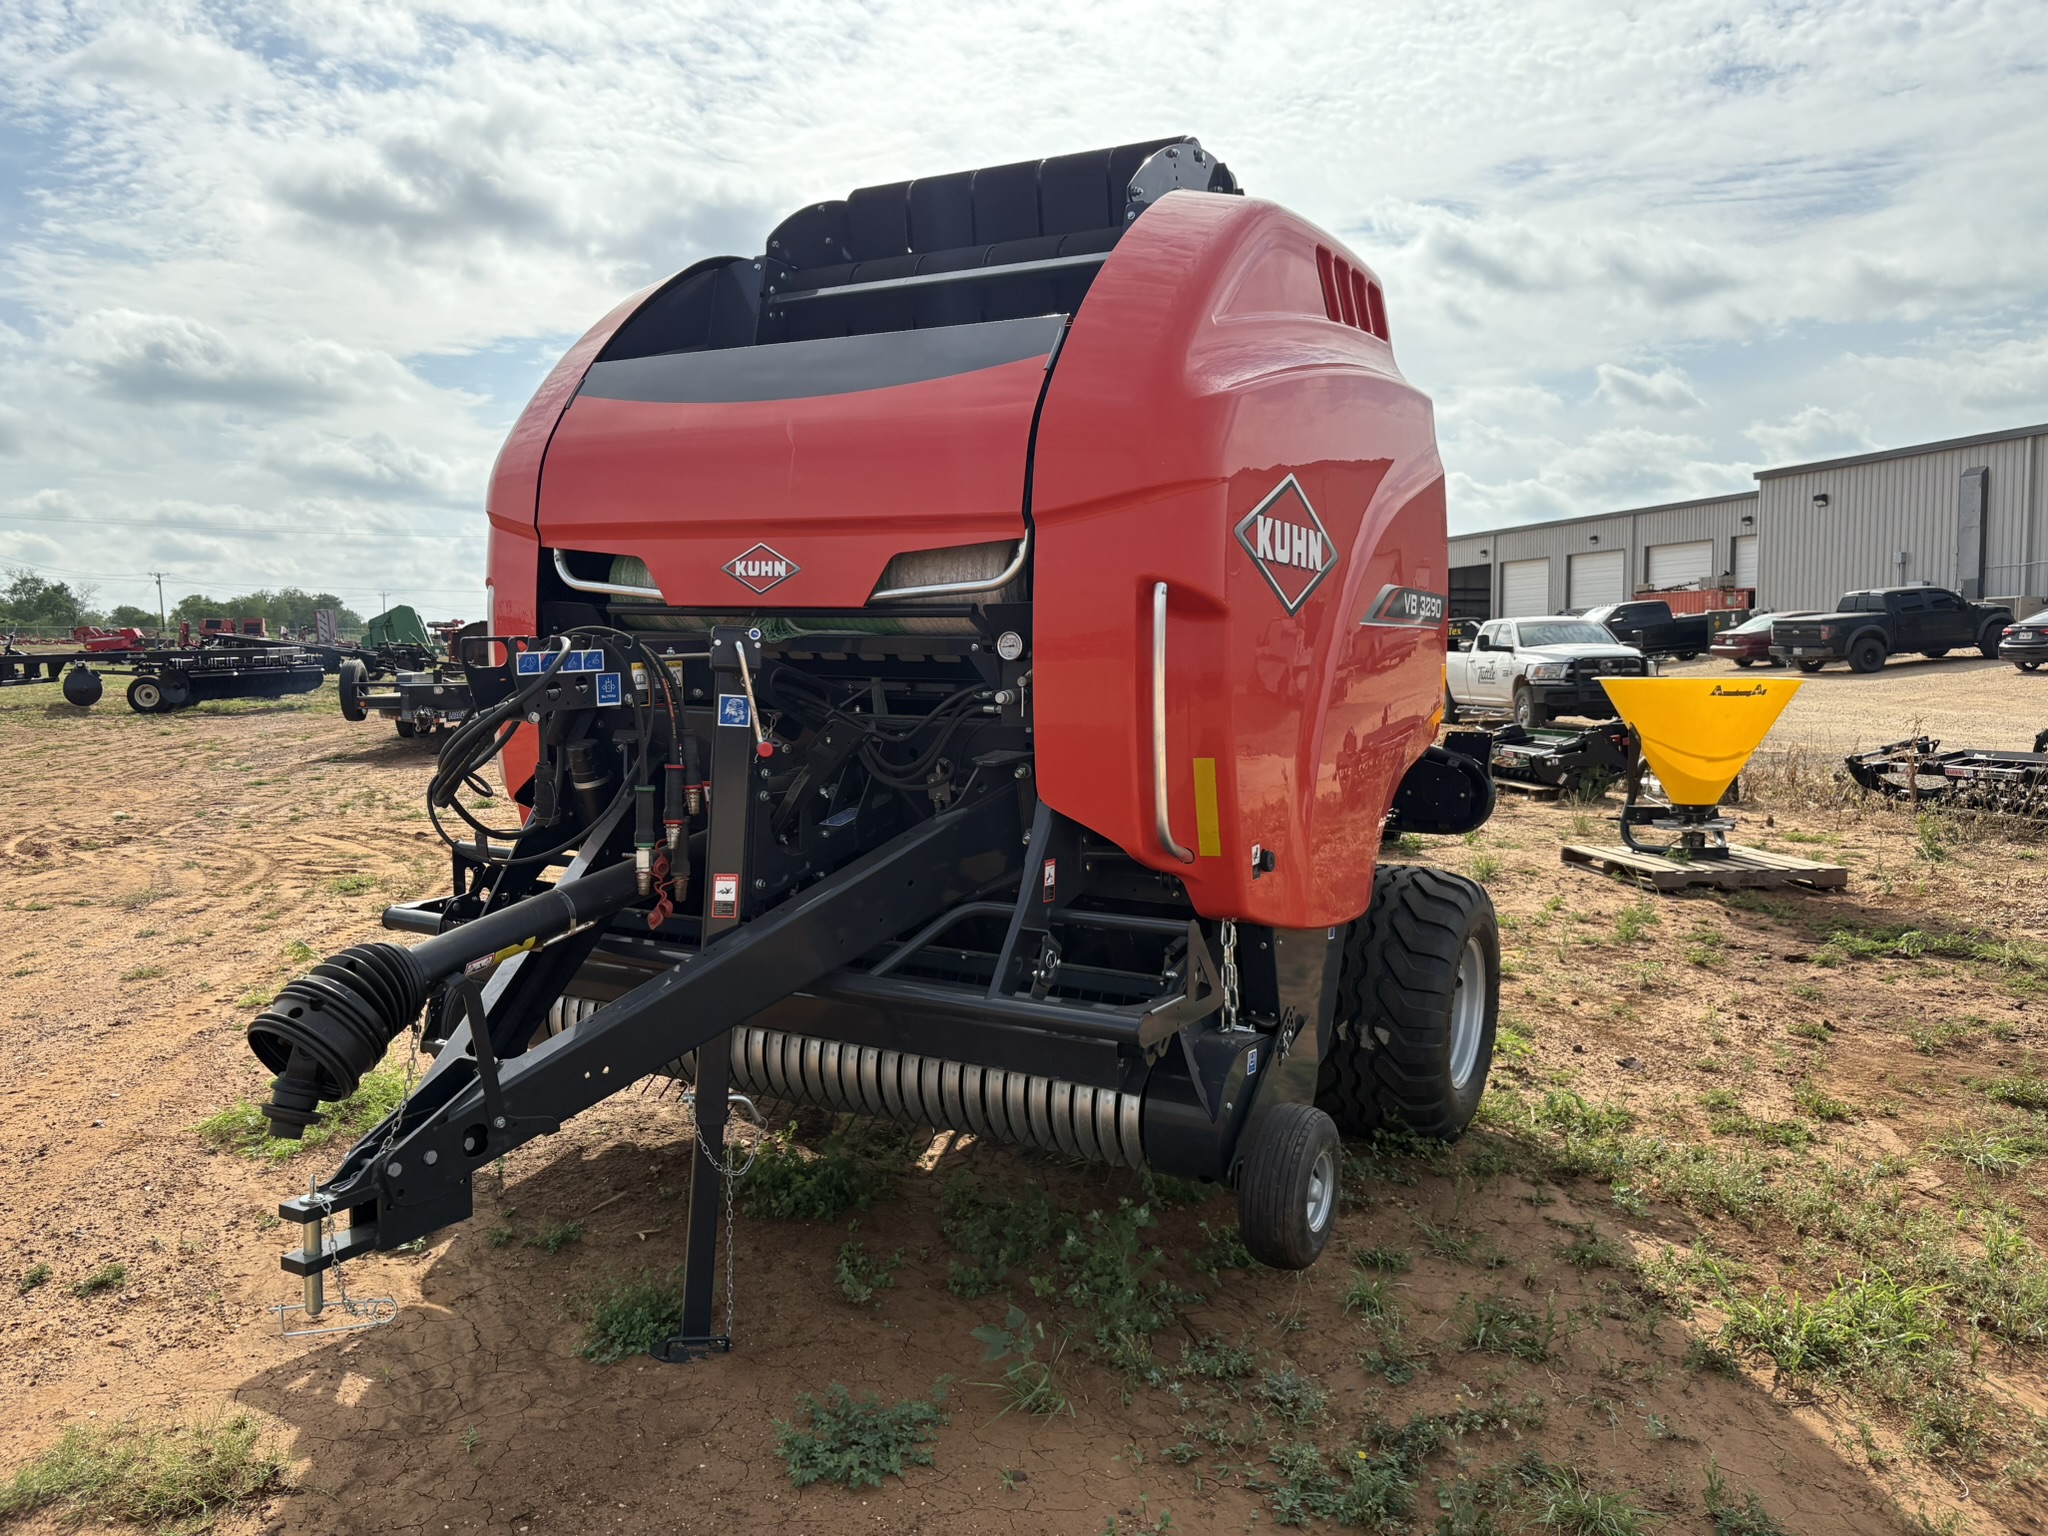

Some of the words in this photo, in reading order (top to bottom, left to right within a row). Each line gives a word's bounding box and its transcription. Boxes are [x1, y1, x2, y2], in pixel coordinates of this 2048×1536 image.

[1257, 514, 1322, 572] KUHN
[735, 560, 787, 577] KUHN
[1404, 592, 1417, 615] VB
[1420, 595, 1442, 618] 3290
